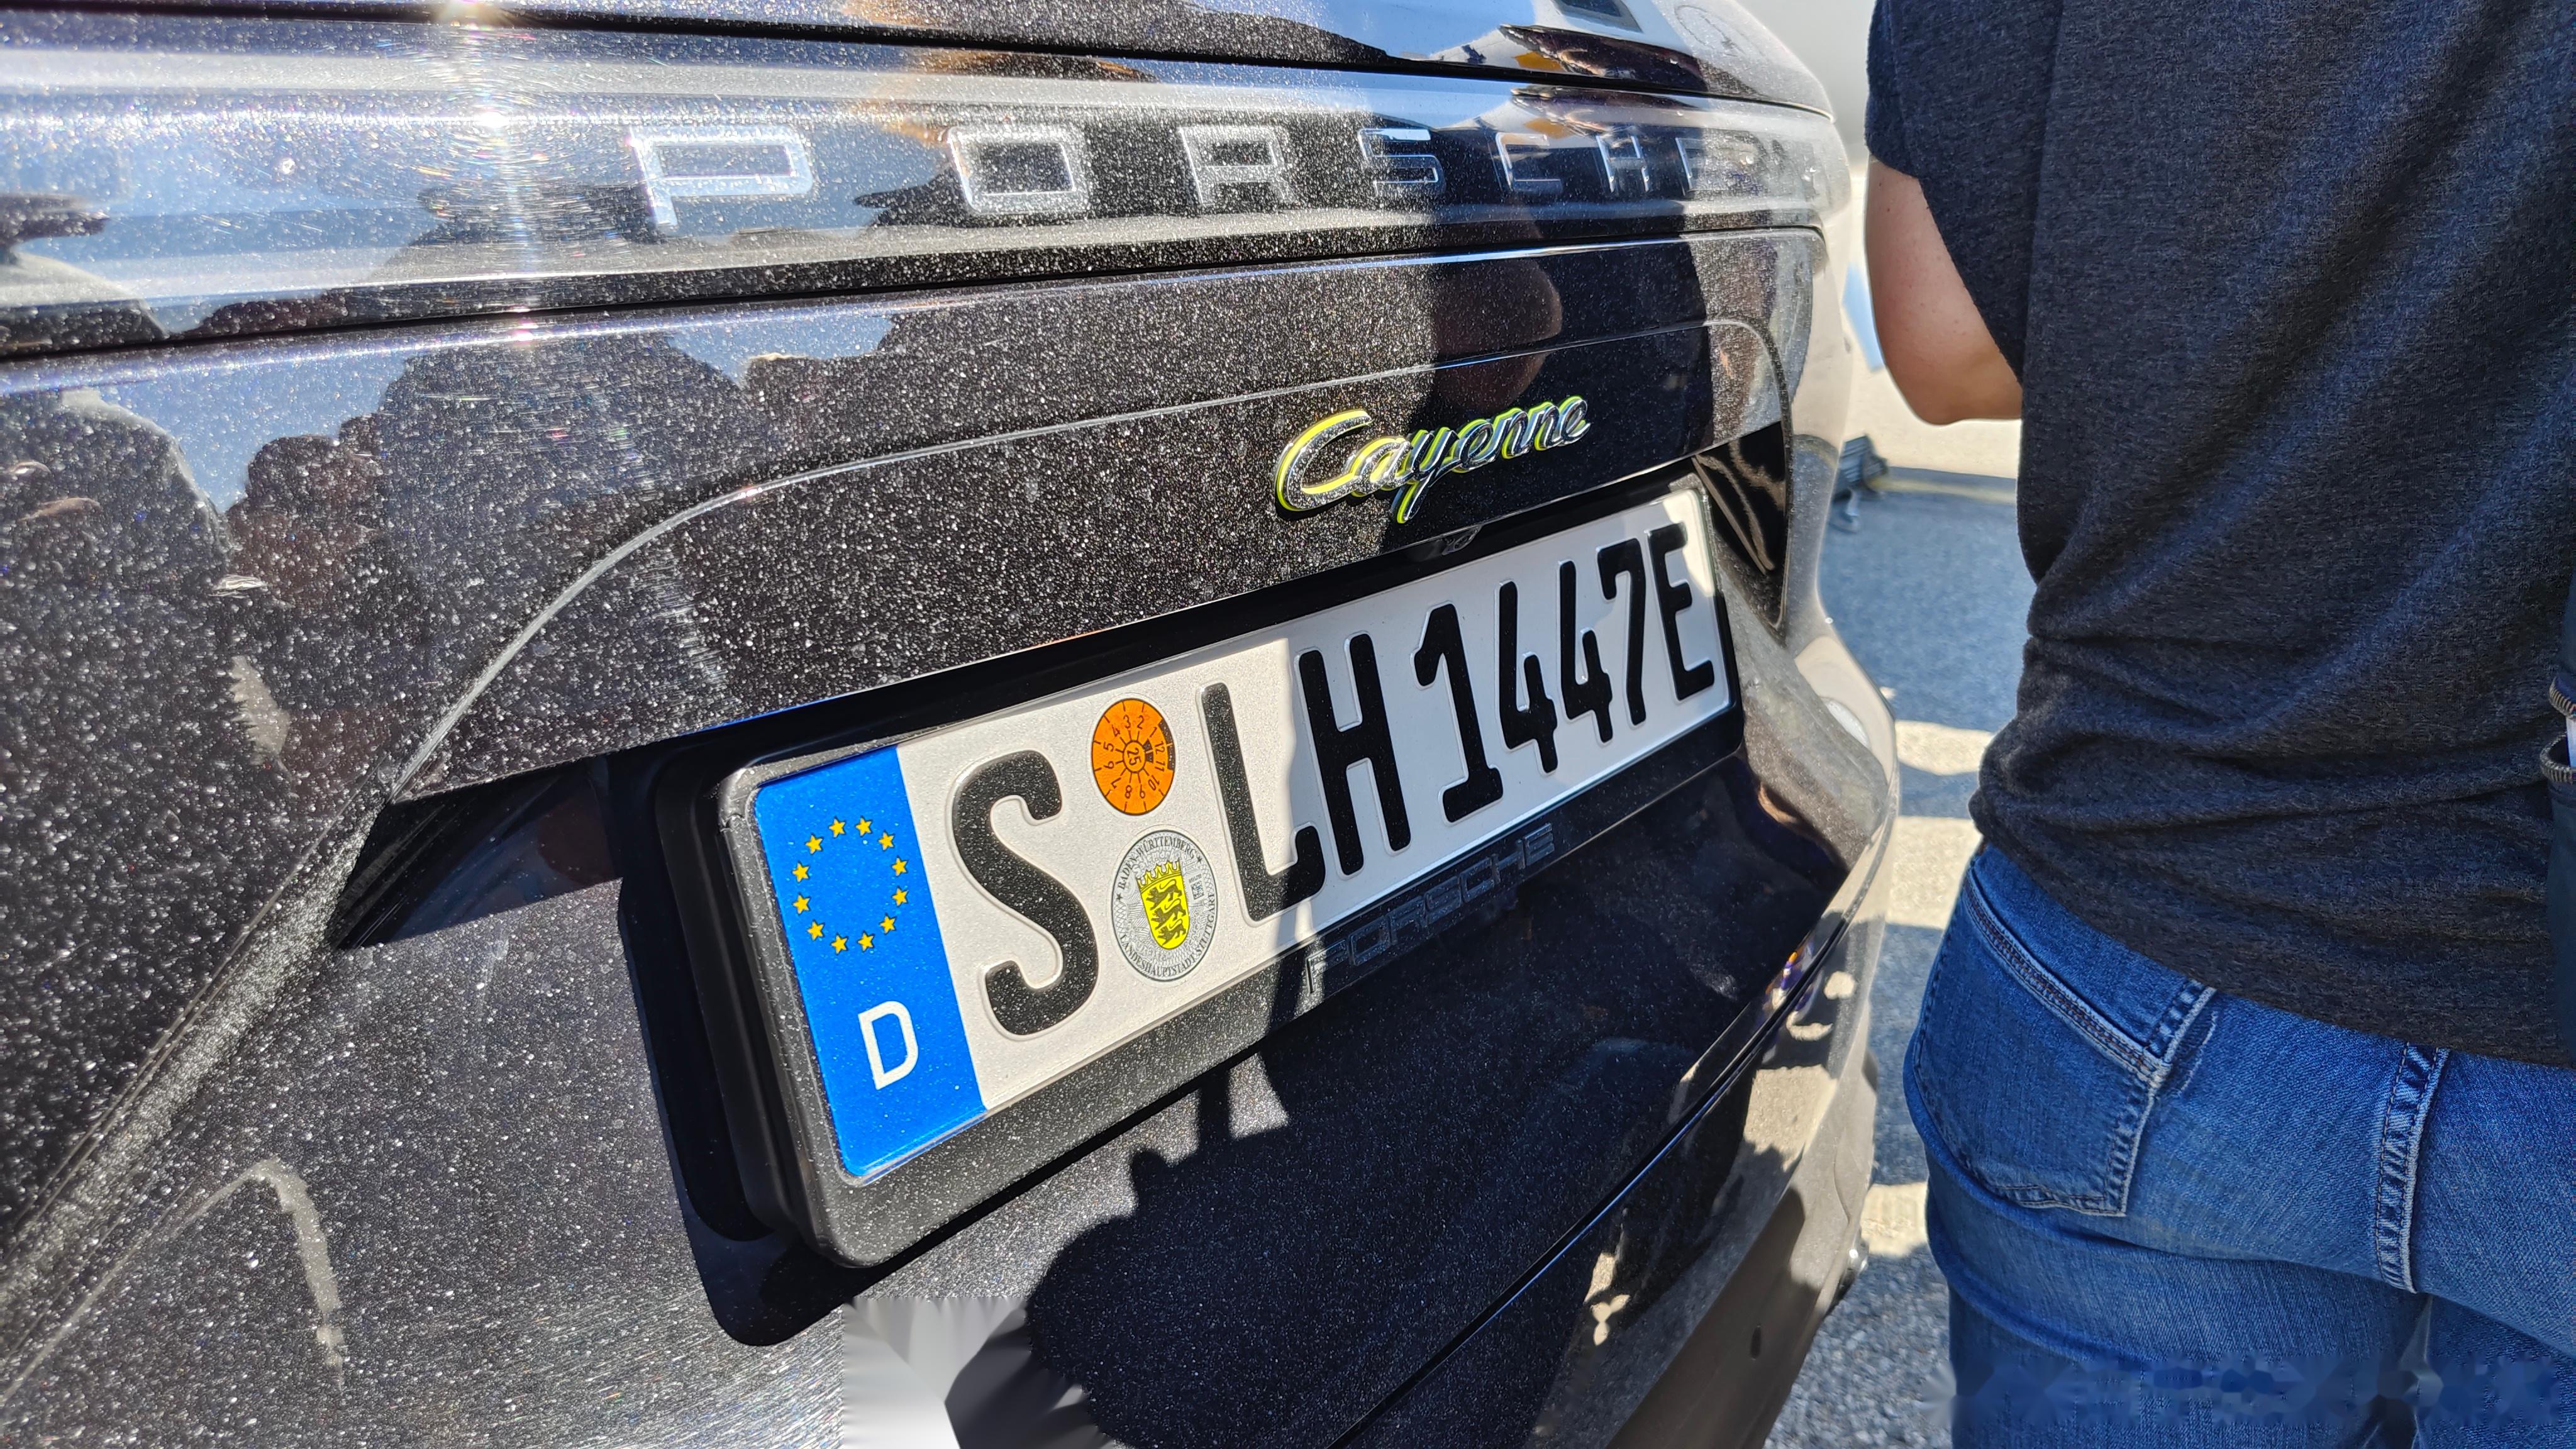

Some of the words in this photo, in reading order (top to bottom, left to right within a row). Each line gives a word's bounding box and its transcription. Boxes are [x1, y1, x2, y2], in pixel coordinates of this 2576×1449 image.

[629, 123, 1761, 230] PORSCHE
[1274, 395, 1592, 524] Cayenne
[952, 748, 1099, 1038] S
[1201, 632, 1411, 923] LH
[1413, 521, 1715, 824] 1447E
[1126, 747, 1142, 765] 25
[1117, 835, 1197, 891] BADEN-WÜRTTEMBERG
[1306, 822, 1555, 994] PORSCHE
[858, 1000, 918, 1090] D
